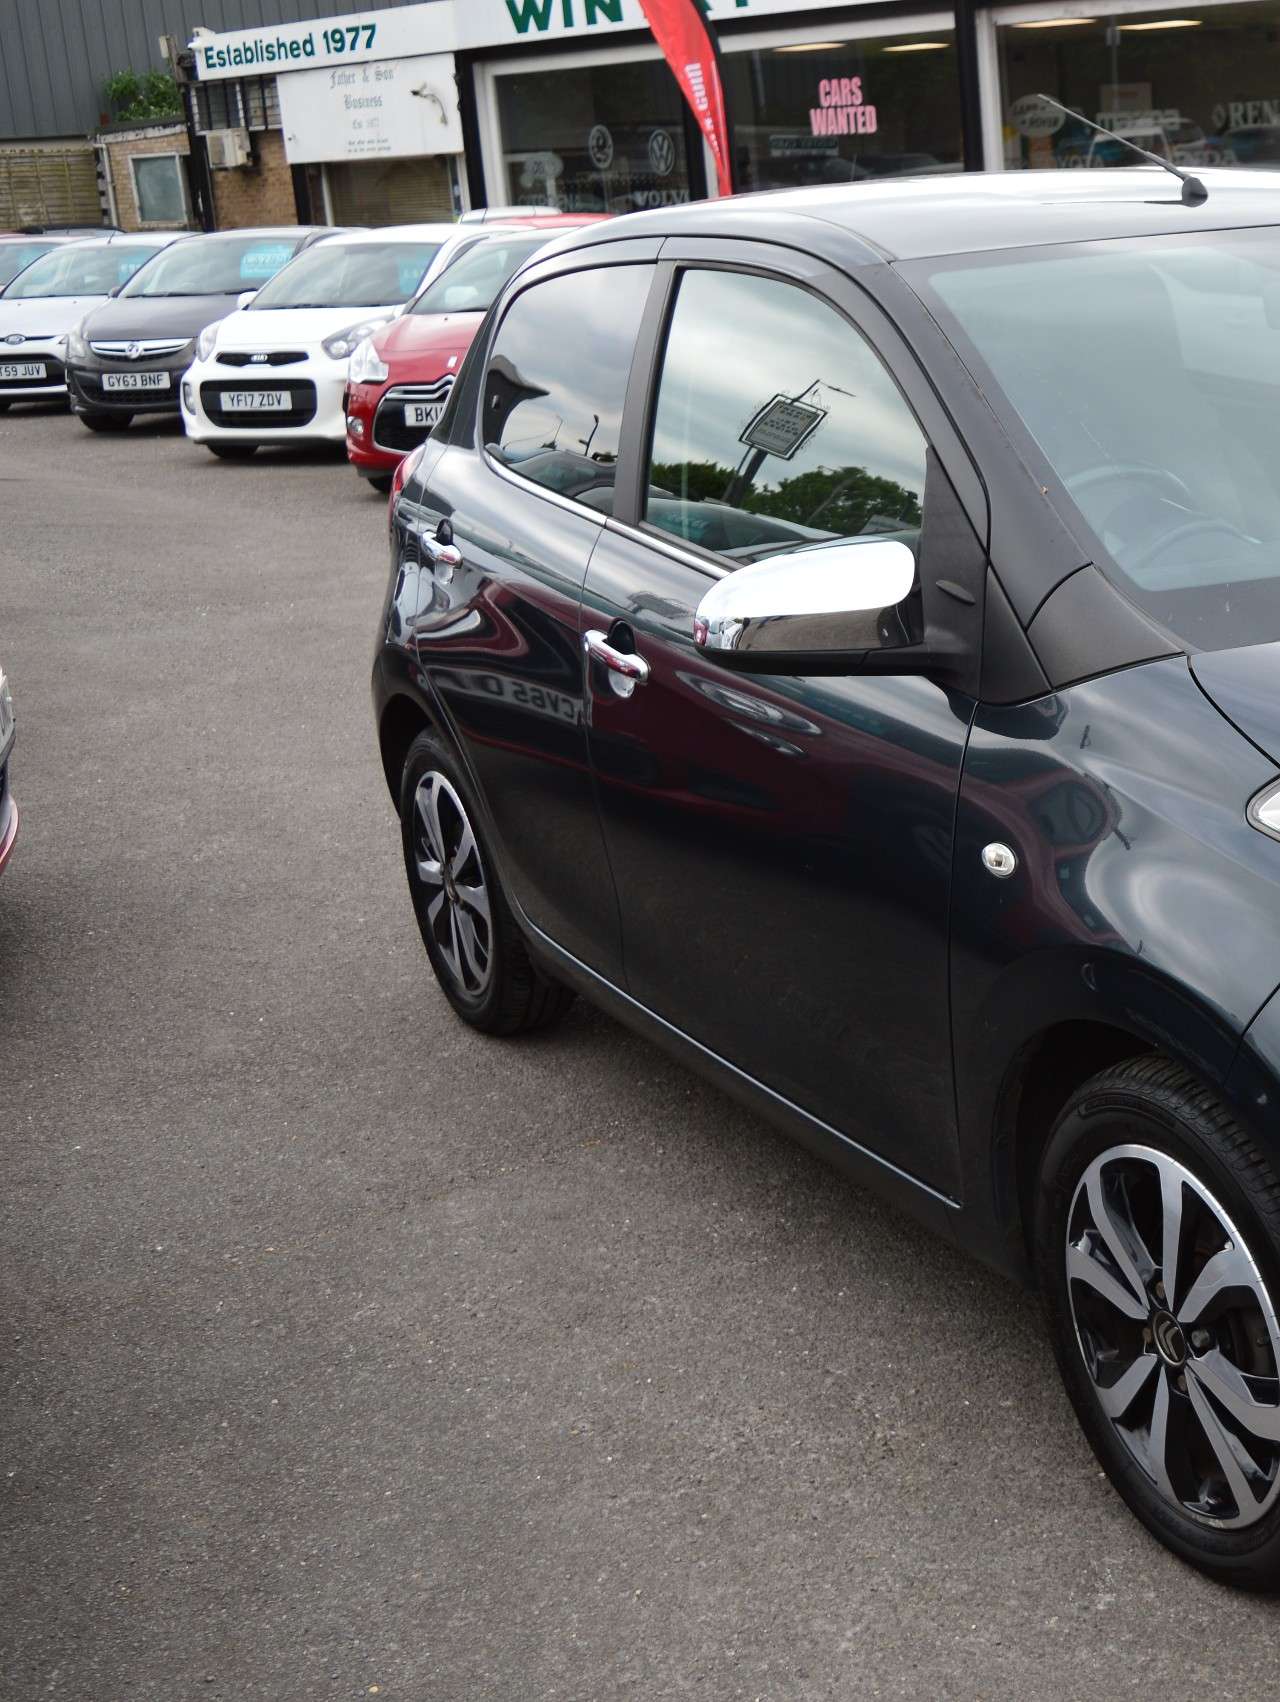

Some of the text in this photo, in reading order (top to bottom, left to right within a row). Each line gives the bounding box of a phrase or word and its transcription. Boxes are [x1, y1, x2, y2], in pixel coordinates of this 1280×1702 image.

[204, 23, 376, 69] Established 1977
[818, 76, 864, 108] CARS
[809, 105, 878, 136] WANTED
[22, 365, 40, 376] JUV
[108, 373, 163, 388] GY63 BNF
[229, 392, 282, 406] YF17 ZDV
